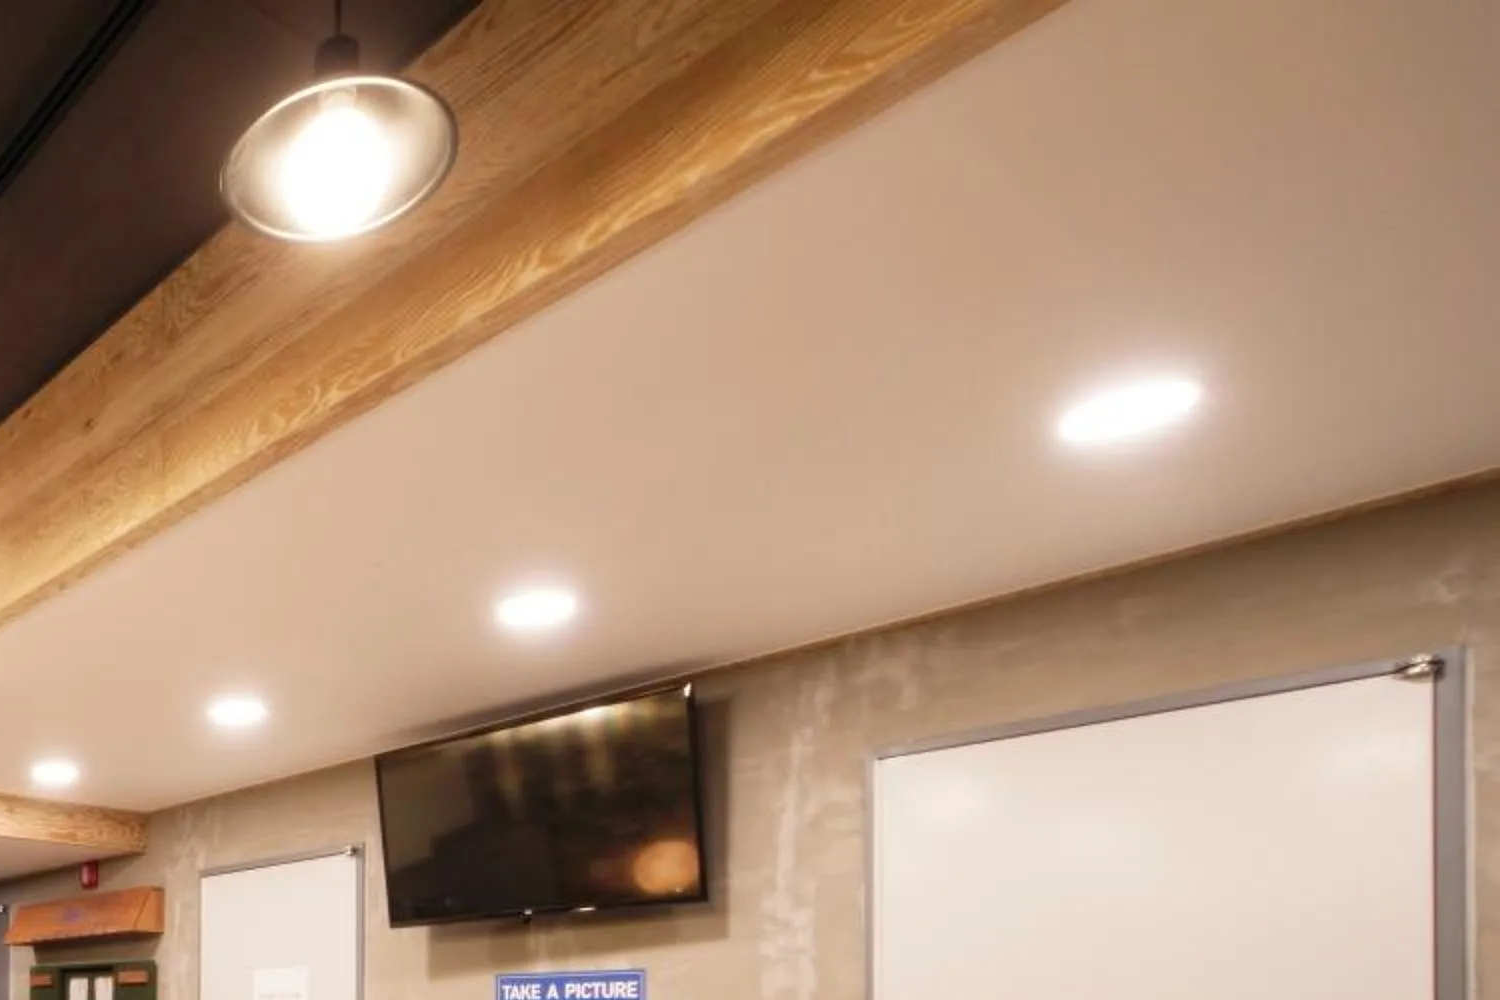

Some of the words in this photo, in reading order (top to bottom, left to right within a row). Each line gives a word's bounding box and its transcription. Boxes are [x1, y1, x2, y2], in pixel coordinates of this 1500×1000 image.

[502, 984, 541, 1000] TAKE
[547, 983, 559, 1000] A
[565, 980, 640, 1000] PICTURE
